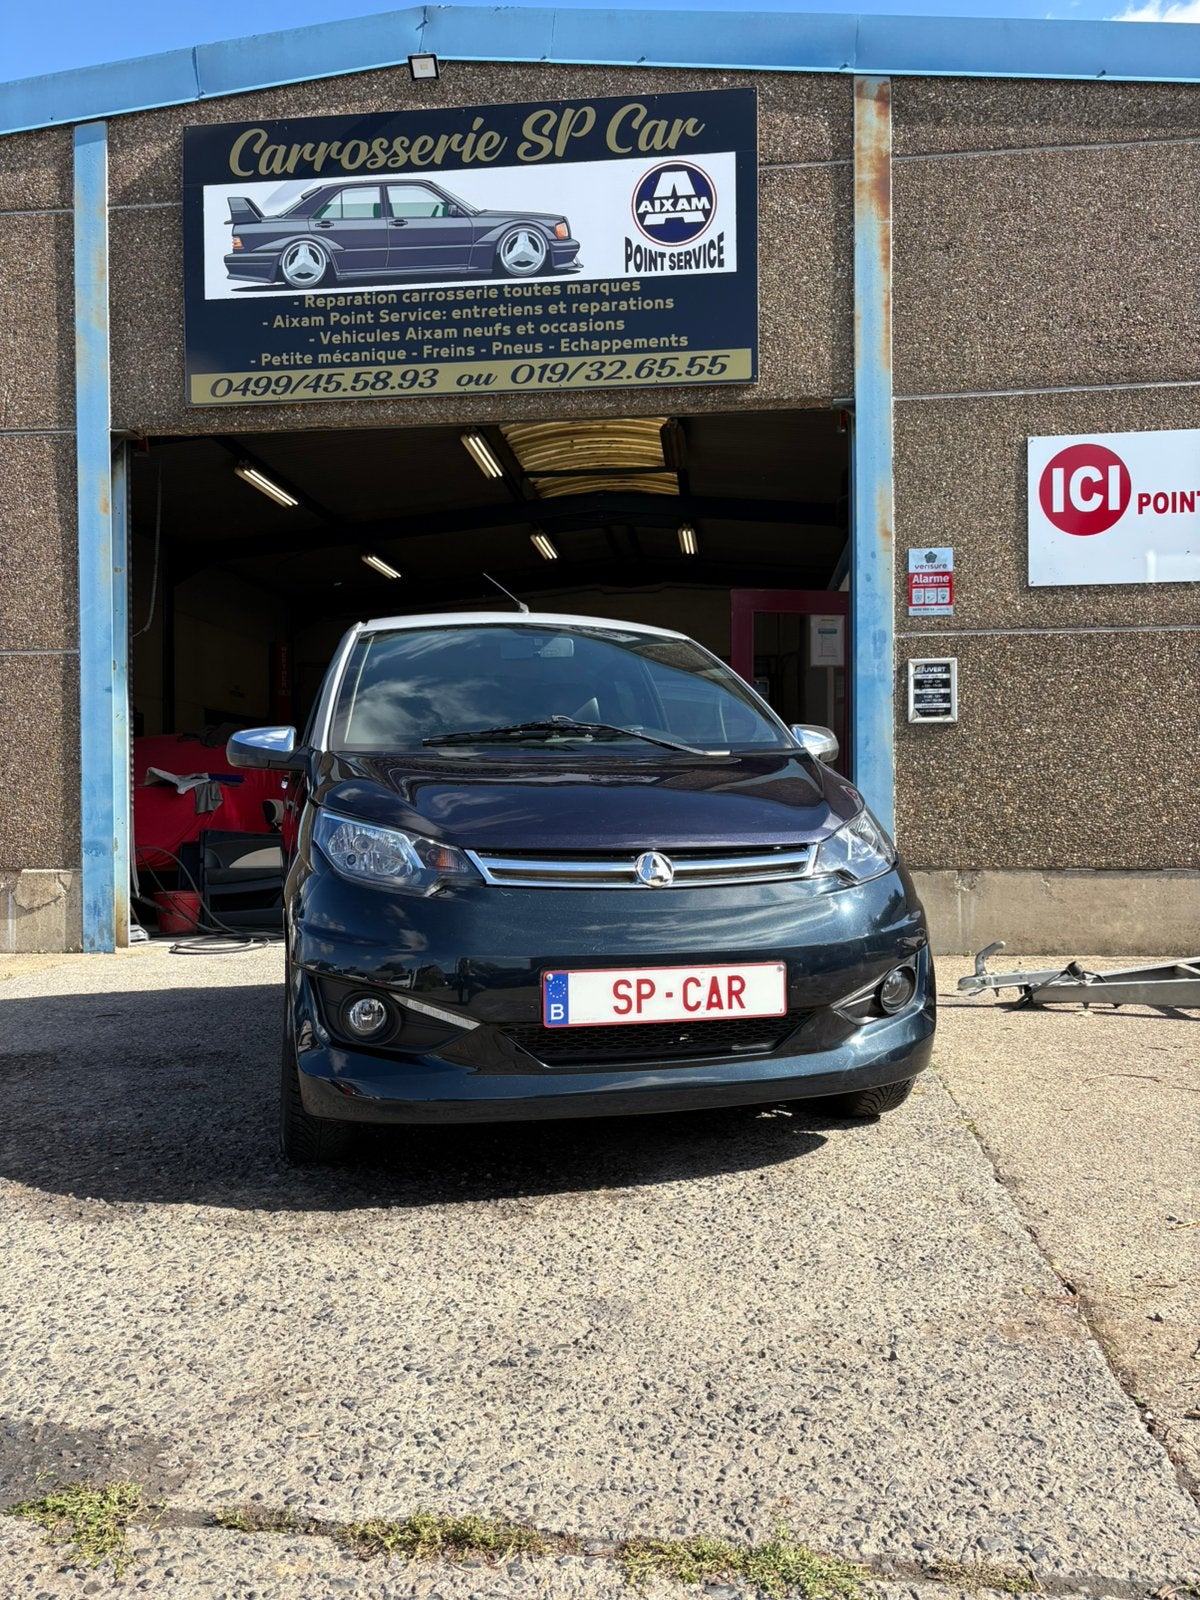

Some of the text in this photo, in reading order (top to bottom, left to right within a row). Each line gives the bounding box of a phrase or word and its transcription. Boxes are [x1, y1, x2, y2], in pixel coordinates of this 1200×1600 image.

[229, 103, 705, 177] Carrosserie SP Car
[637, 197, 711, 213] AIXAM
[625, 231, 724, 273] POINT SERVICE
[304, 291, 397, 310] Reparation
[402, 286, 498, 304] carrosserie
[503, 283, 561, 298] toutes
[567, 280, 641, 296] marques
[273, 314, 324, 329] Aixam
[330, 310, 374, 326] Point
[379, 308, 447, 323] Service:
[452, 303, 543, 320] entretiens
[548, 301, 567, 315] et
[572, 297, 674, 316] reparations
[320, 328, 400, 345] Vehicules
[405, 326, 458, 341] Aixam
[463, 322, 511, 338] neufs
[516, 321, 535, 335] et
[540, 318, 625, 333] occasions
[261, 351, 313, 367] Petite
[318, 347, 407, 364] mécanique
[423, 344, 475, 359] Freins
[492, 341, 543, 355] Pneus
[560, 333, 688, 353] Echappements
[210, 354, 731, 398] 0499/45.58.93 ou 019/32.65.55
[1051, 464, 1120, 513] ICI
[1137, 490, 1200, 515] POIN
[912, 574, 949, 584] Alarme
[550, 1003, 564, 1021] B
